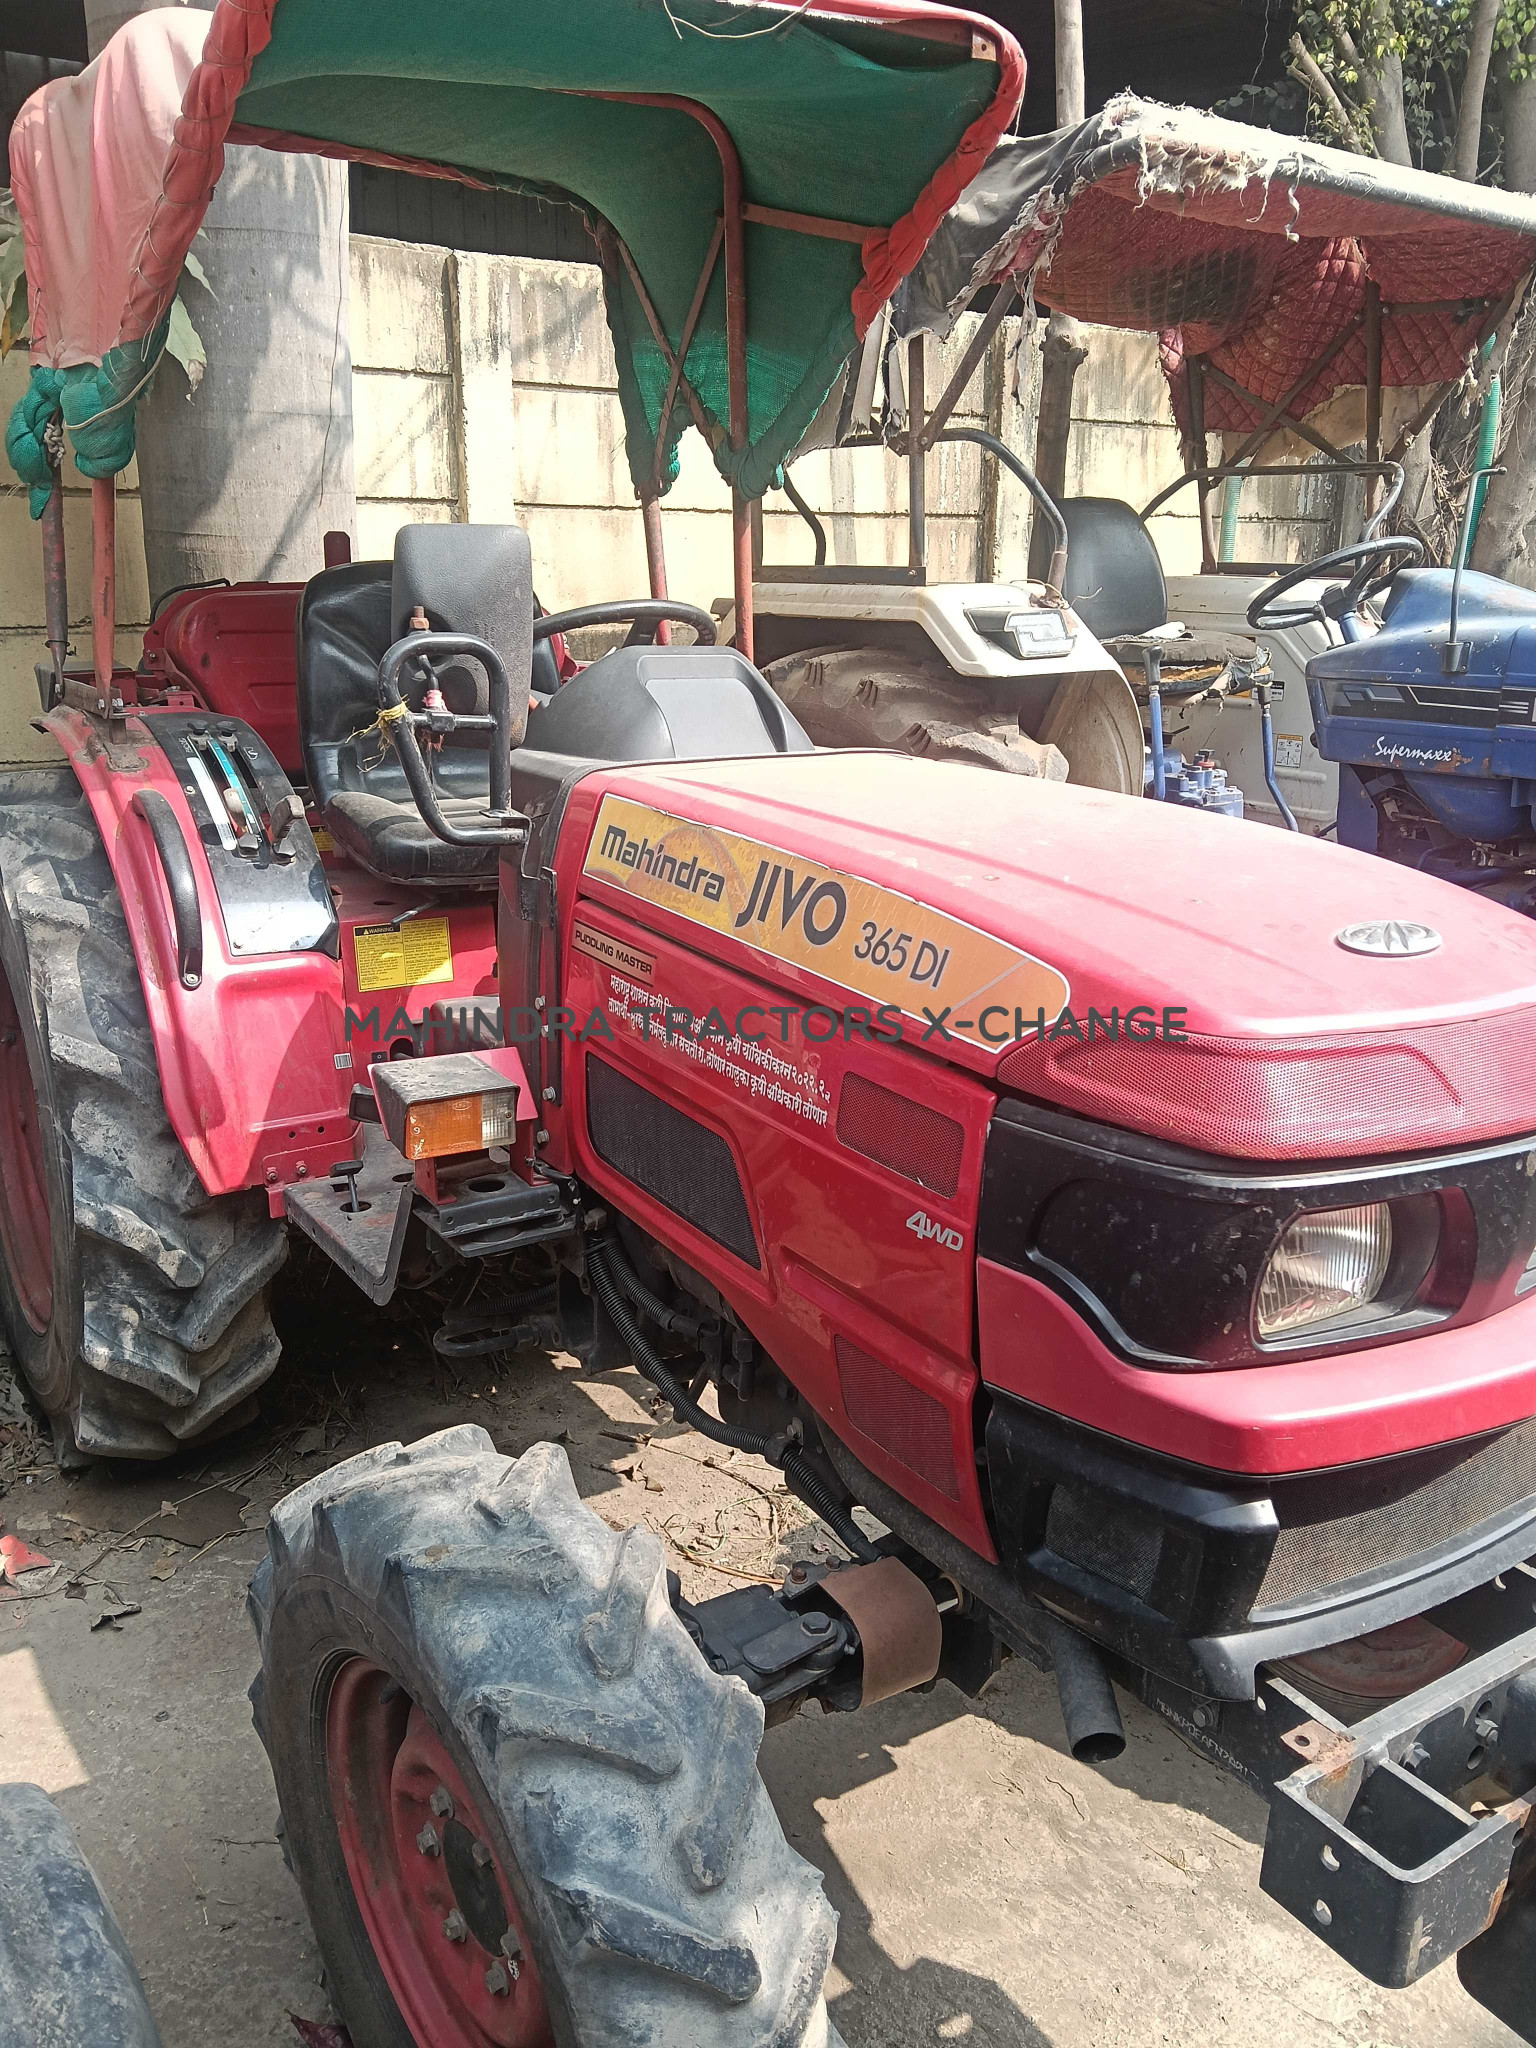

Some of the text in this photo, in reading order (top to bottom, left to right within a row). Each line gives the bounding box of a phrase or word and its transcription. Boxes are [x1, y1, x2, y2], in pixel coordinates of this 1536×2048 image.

[1375, 735, 1452, 763] Supermaxx
[600, 825, 950, 988] Mahindra JIVO 365 DI
[574, 930, 653, 975] PUDDLING MASTER
[906, 1210, 964, 1252] 4WD
